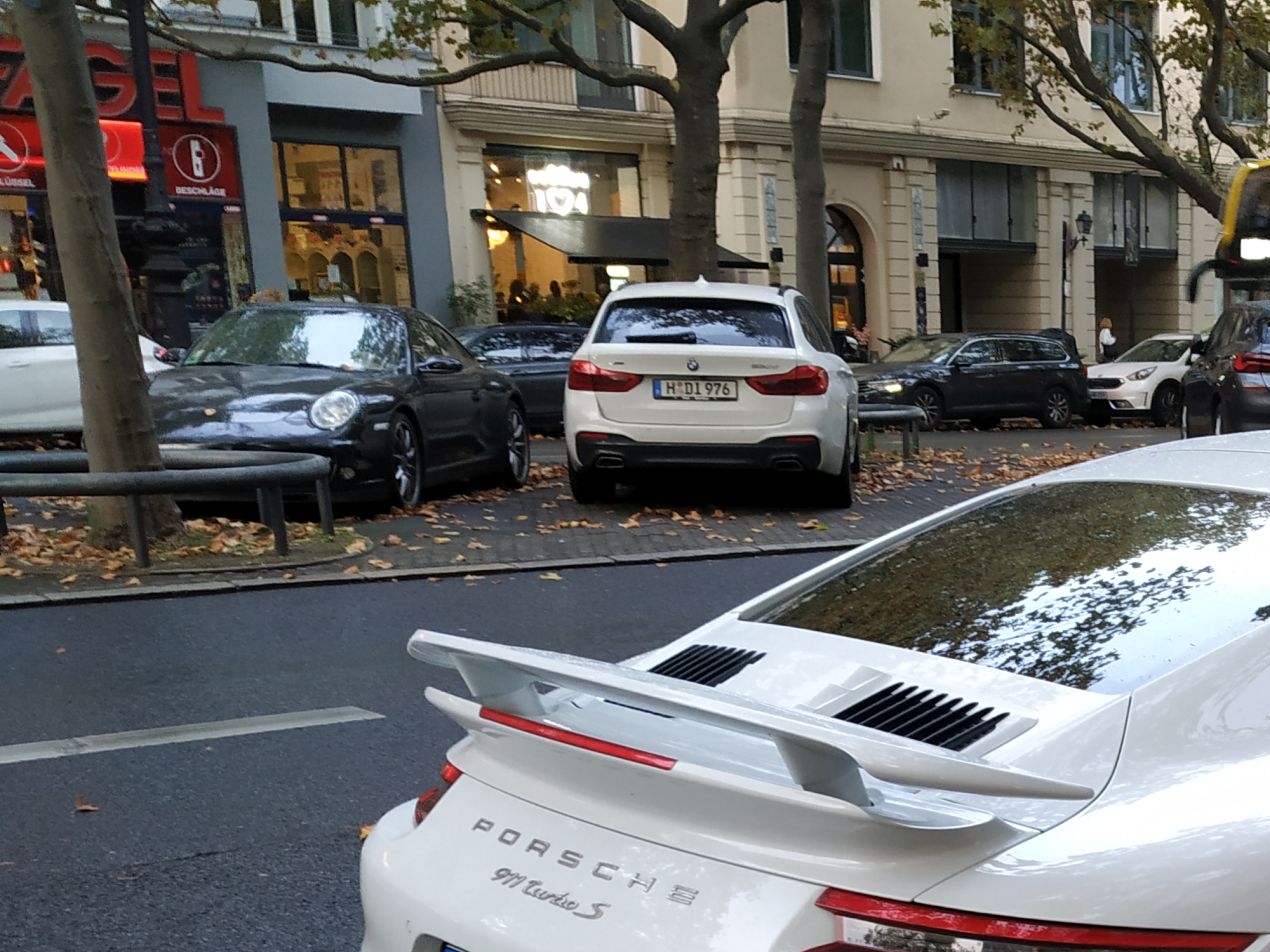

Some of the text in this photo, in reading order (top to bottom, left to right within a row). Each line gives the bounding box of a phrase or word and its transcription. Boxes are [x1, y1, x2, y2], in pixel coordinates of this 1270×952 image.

[666, 382, 676, 395] H
[705, 383, 730, 396] 976
[472, 818, 700, 906] PORSCHE
[491, 867, 525, 890] 911
[572, 902, 611, 920] S
